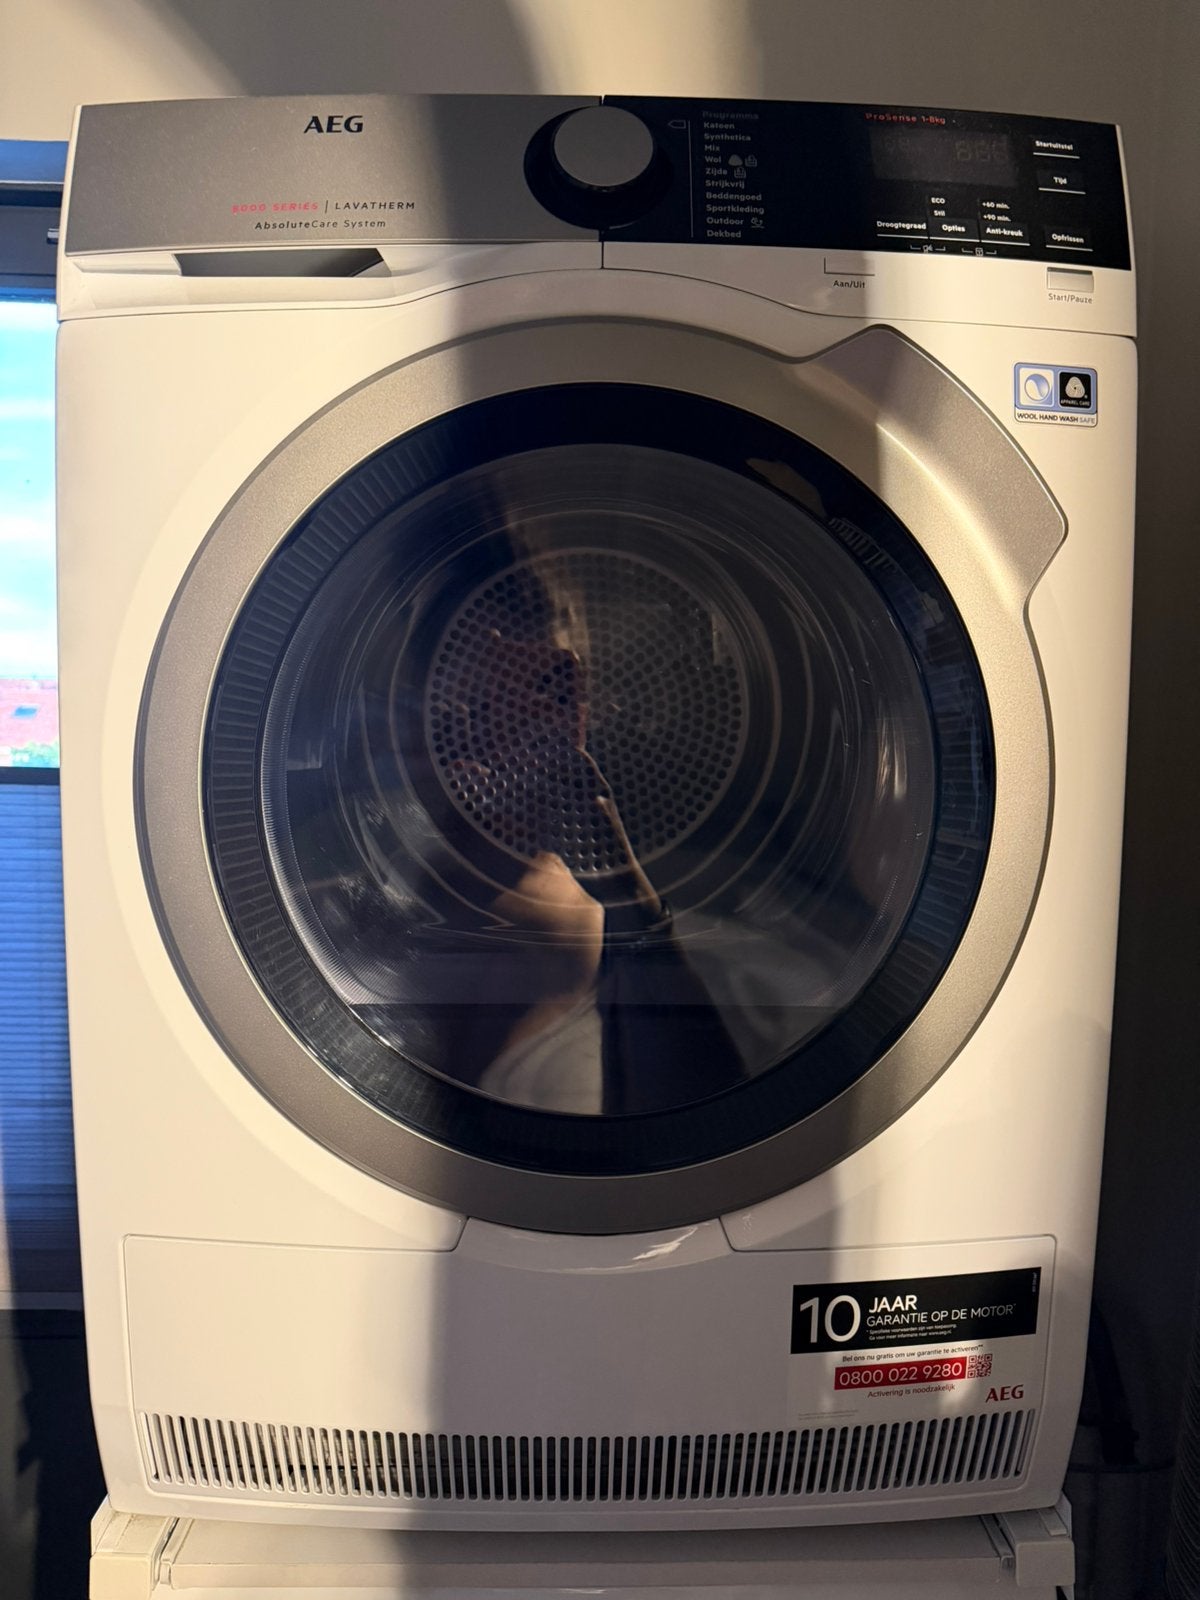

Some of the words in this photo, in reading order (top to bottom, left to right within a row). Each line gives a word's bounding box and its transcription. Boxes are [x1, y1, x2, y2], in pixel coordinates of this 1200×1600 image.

[865, 112, 917, 122] ProSense
[303, 115, 364, 134] AEG
[703, 121, 736, 130] Katoen
[704, 133, 752, 142] Synthetica
[704, 144, 721, 152] Mix
[1034, 140, 1073, 151] Startuitstel
[705, 155, 722, 164] Wol
[705, 167, 728, 177] Zijde
[705, 179, 745, 190] Strijkvrij
[1053, 176, 1068, 186] Tijd
[706, 191, 762, 202] Beddengoed
[931, 197, 946, 205] ECO
[272, 202, 319, 213] SERIES
[335, 202, 416, 211] LAVATHERM
[706, 203, 765, 215] Sportkleding
[255, 220, 339, 231] AbsoluteCare
[343, 220, 387, 230] System
[706, 216, 745, 226] Outdoor
[876, 220, 927, 231] Droogtegraad
[706, 229, 742, 239] Dekbed
[942, 224, 966, 234] Opties
[986, 227, 1024, 238] Anti-kreuk
[1051, 233, 1085, 245] Opfrissen
[833, 279, 866, 290] Aan/Uit
[1048, 292, 1093, 305] Start/Pauze
[1017, 412, 1038, 421] WOOL
[1039, 414, 1058, 422] HAND
[1059, 415, 1079, 424] WASH
[1079, 416, 1096, 425] SAFE
[868, 1295, 918, 1314] JAAR
[800, 1294, 862, 1344] 10
[866, 1311, 928, 1328] GARANTIE
[931, 1310, 949, 1323] OP
[951, 1308, 968, 1321] DE
[842, 1355, 853, 1363] Bel
[853, 1354, 866, 1362] ons
[875, 1352, 894, 1362] gratis
[916, 1348, 942, 1359] garantie
[839, 1369, 884, 1387] 0800
[888, 1366, 918, 1383] 022
[922, 1361, 963, 1380] 9280
[867, 1388, 904, 1399] Activering
[912, 1383, 956, 1396] noodzakelijk
[985, 1384, 1024, 1403] AEG
